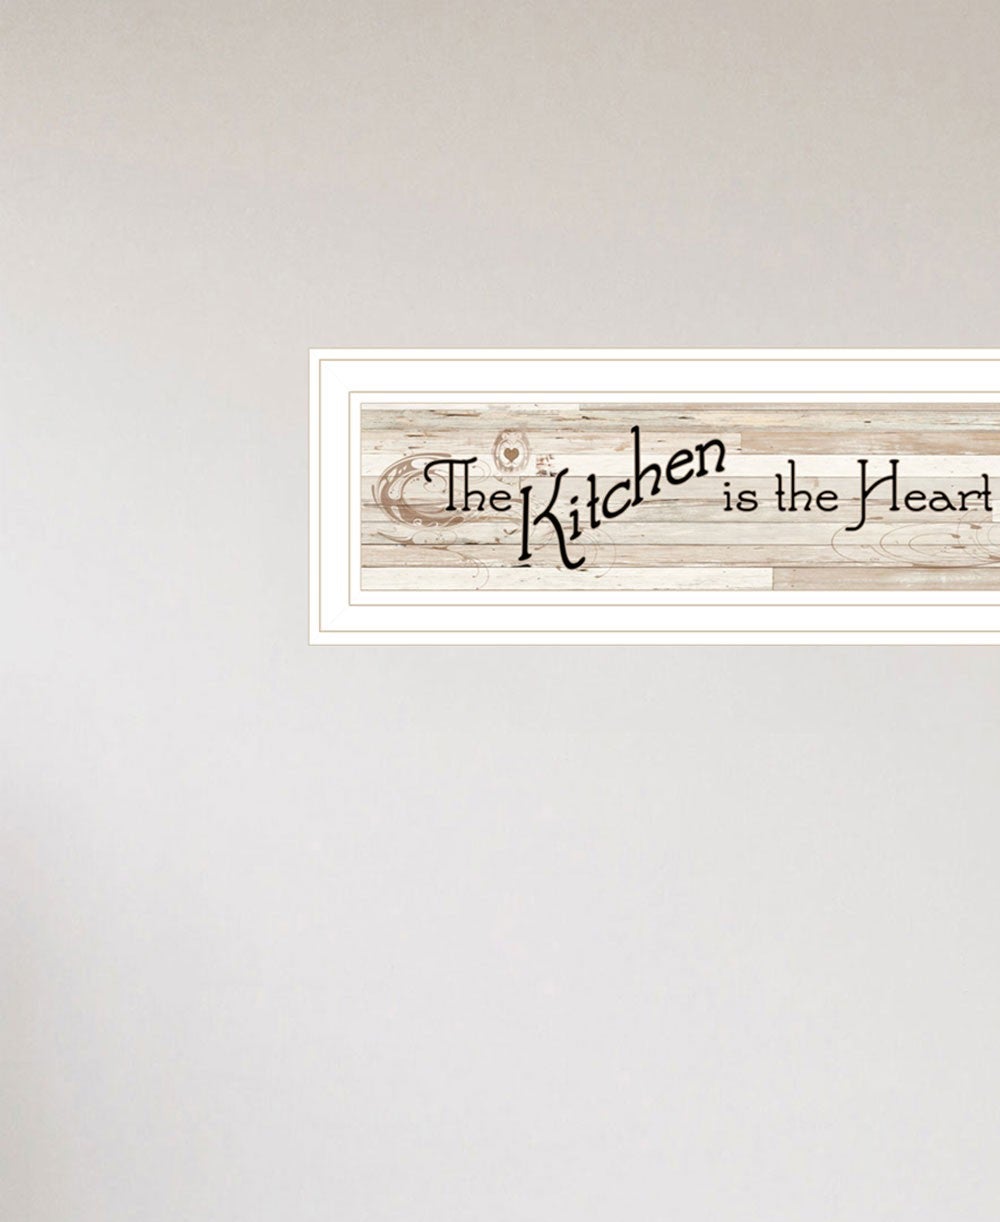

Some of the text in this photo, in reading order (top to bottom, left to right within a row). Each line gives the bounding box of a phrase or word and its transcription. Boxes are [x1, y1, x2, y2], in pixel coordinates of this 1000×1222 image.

[423, 456, 512, 512] The
[518, 425, 726, 570] Kitchen
[723, 482, 758, 512] is
[775, 459, 838, 512] the
[845, 459, 993, 532] Heart
